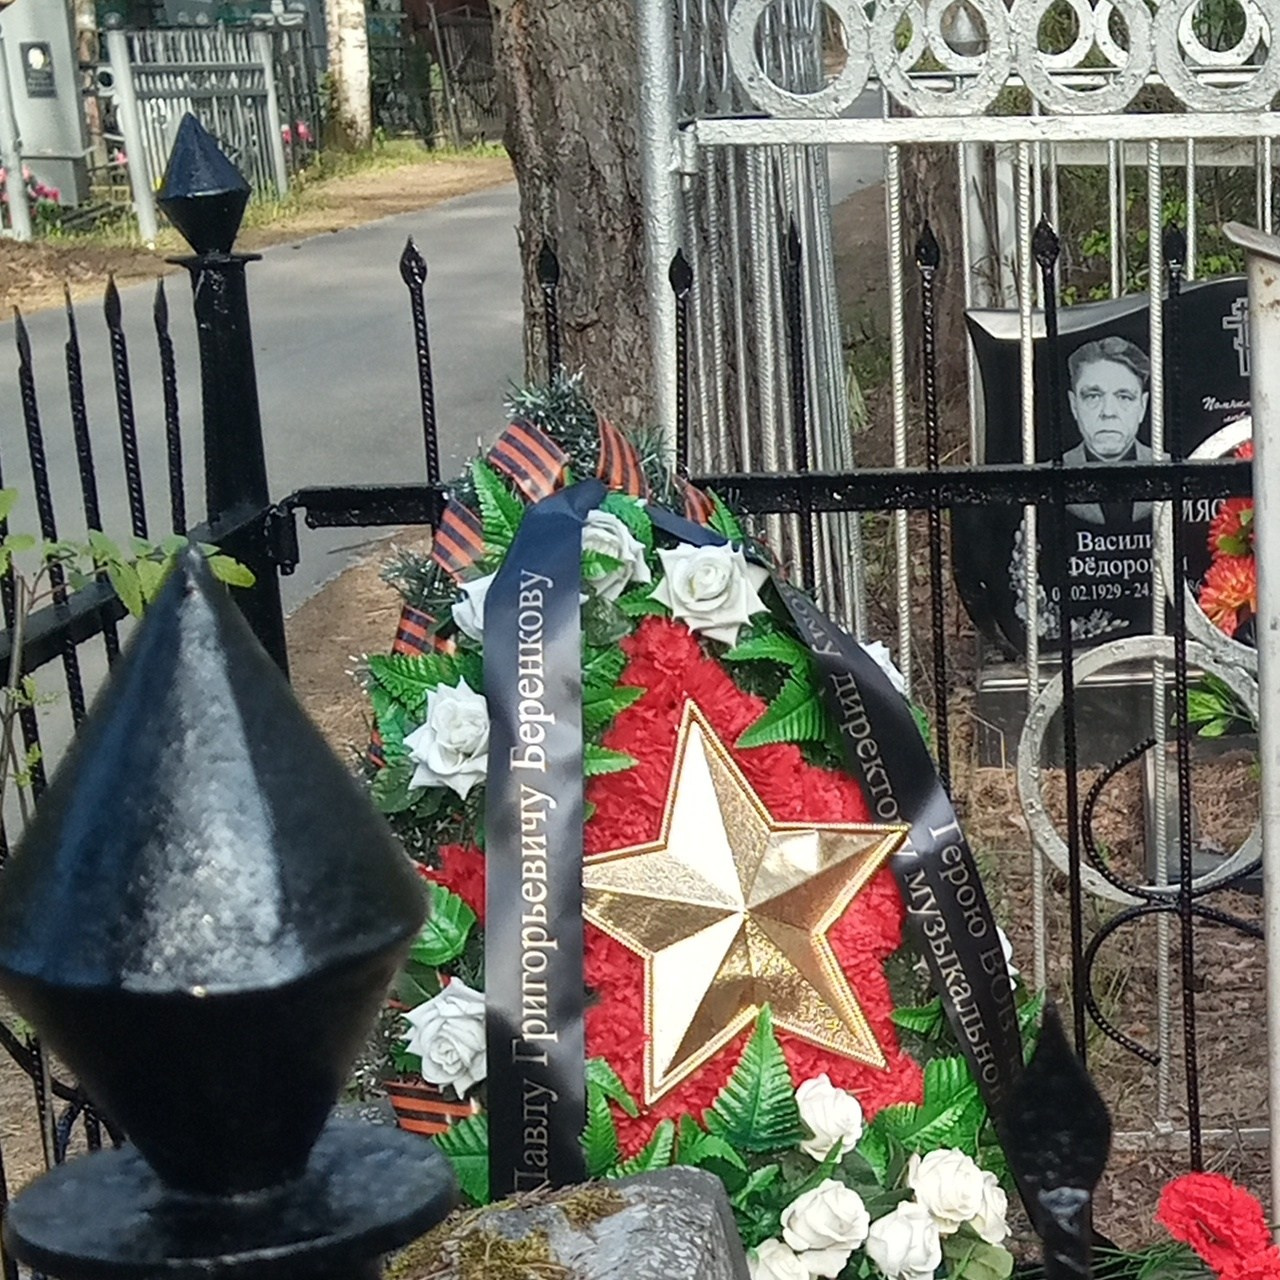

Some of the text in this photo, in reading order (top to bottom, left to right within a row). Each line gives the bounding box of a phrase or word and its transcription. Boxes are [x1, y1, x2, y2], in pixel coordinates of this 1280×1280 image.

[510, 569, 557, 772] Беренкову
[512, 784, 558, 1066] Григорьевичу
[904, 869, 1001, 1104] музыкально
[929, 820, 987, 939] Герою
